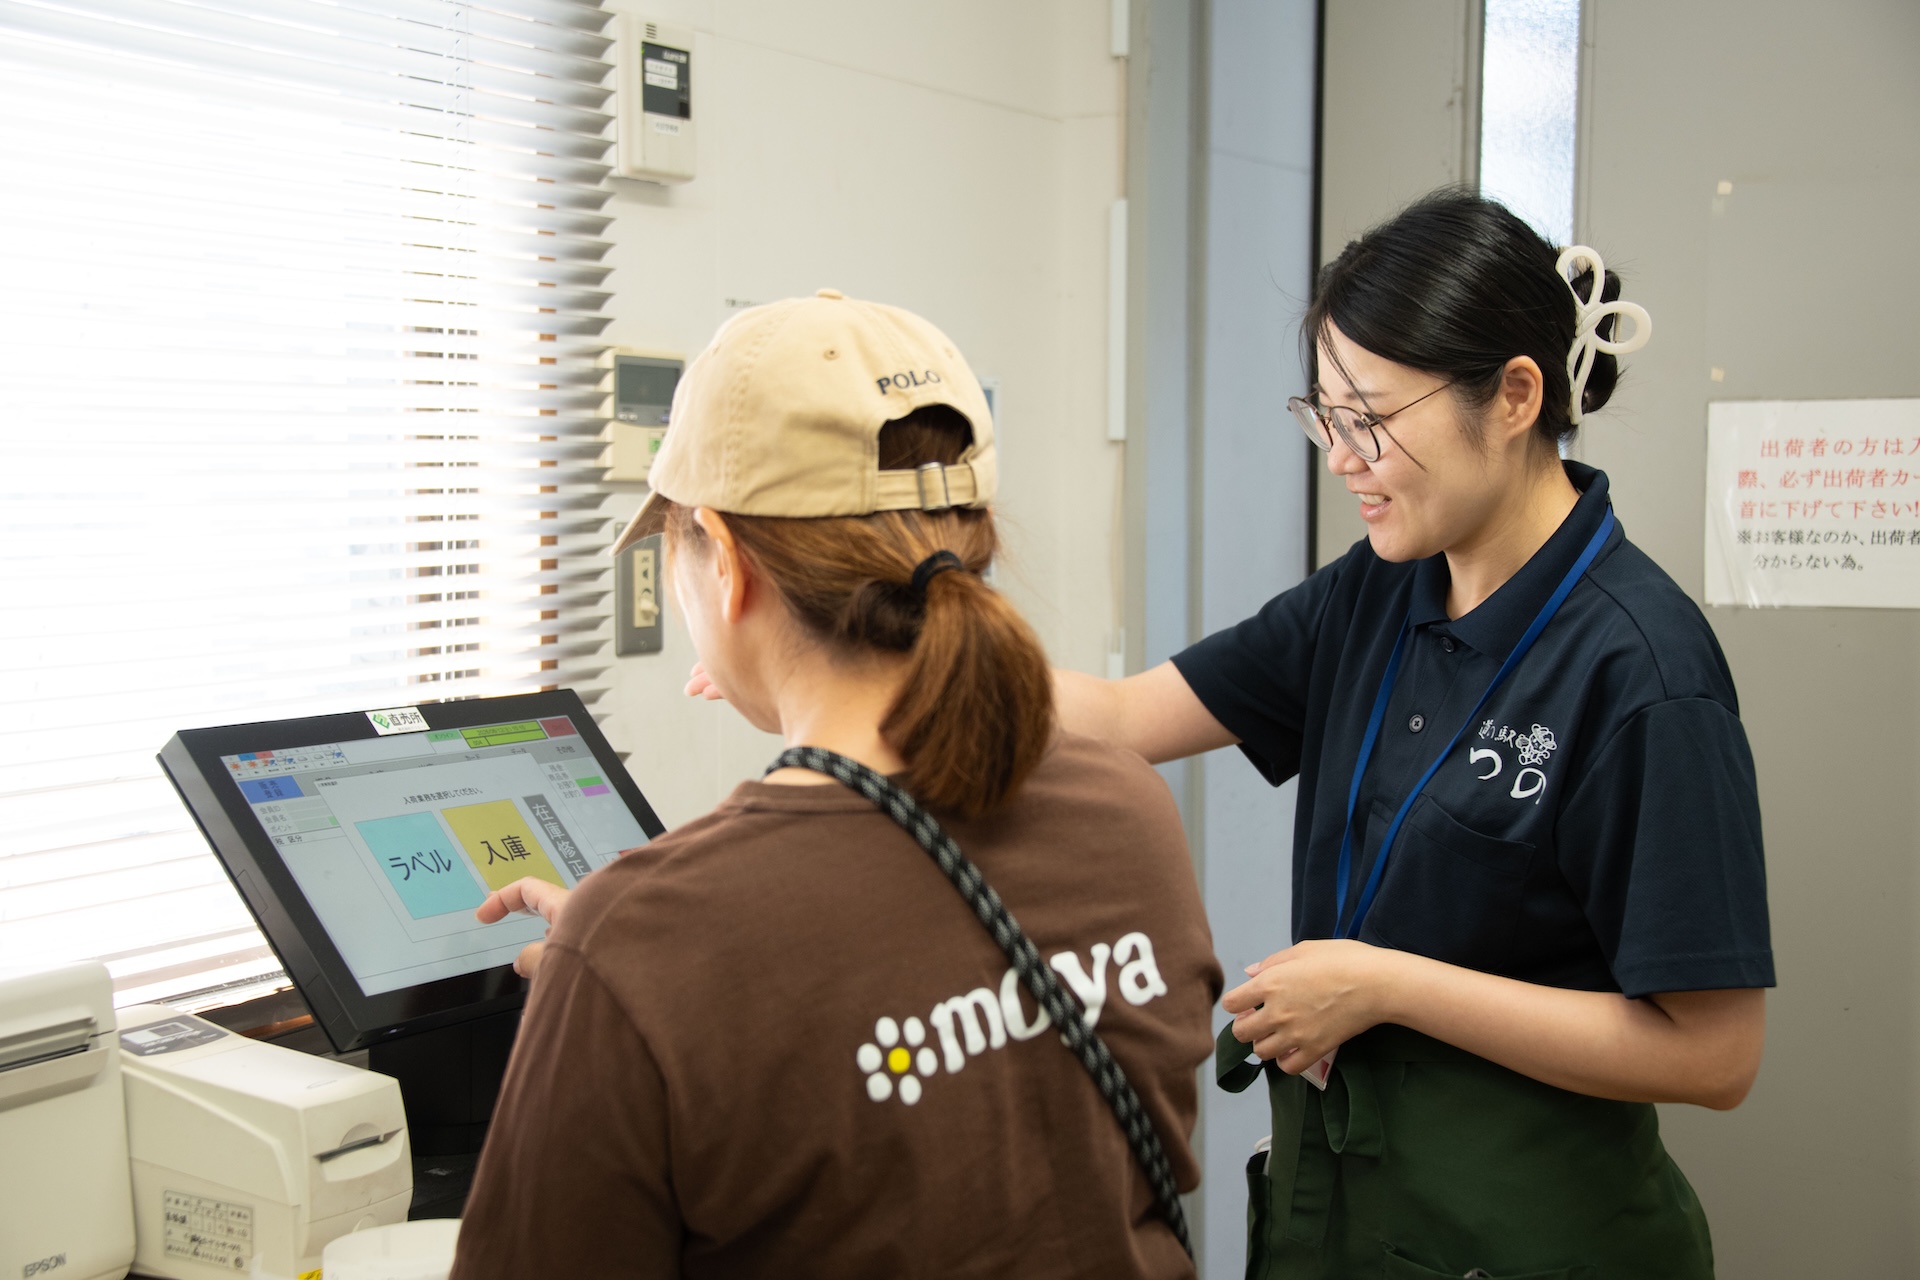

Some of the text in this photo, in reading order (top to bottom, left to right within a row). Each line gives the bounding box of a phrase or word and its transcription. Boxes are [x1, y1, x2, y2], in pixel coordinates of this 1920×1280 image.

[876, 370, 941, 396] POLO
[1753, 554, 1864, 571] 分からない為。
[388, 712, 423, 726] 直売所
[1469, 746, 1547, 805] つの
[480, 835, 531, 865] 入庫
[532, 803, 590, 877] 在庫修正
[388, 849, 452, 881] ラベル
[24, 1251, 67, 1279] EPSON
